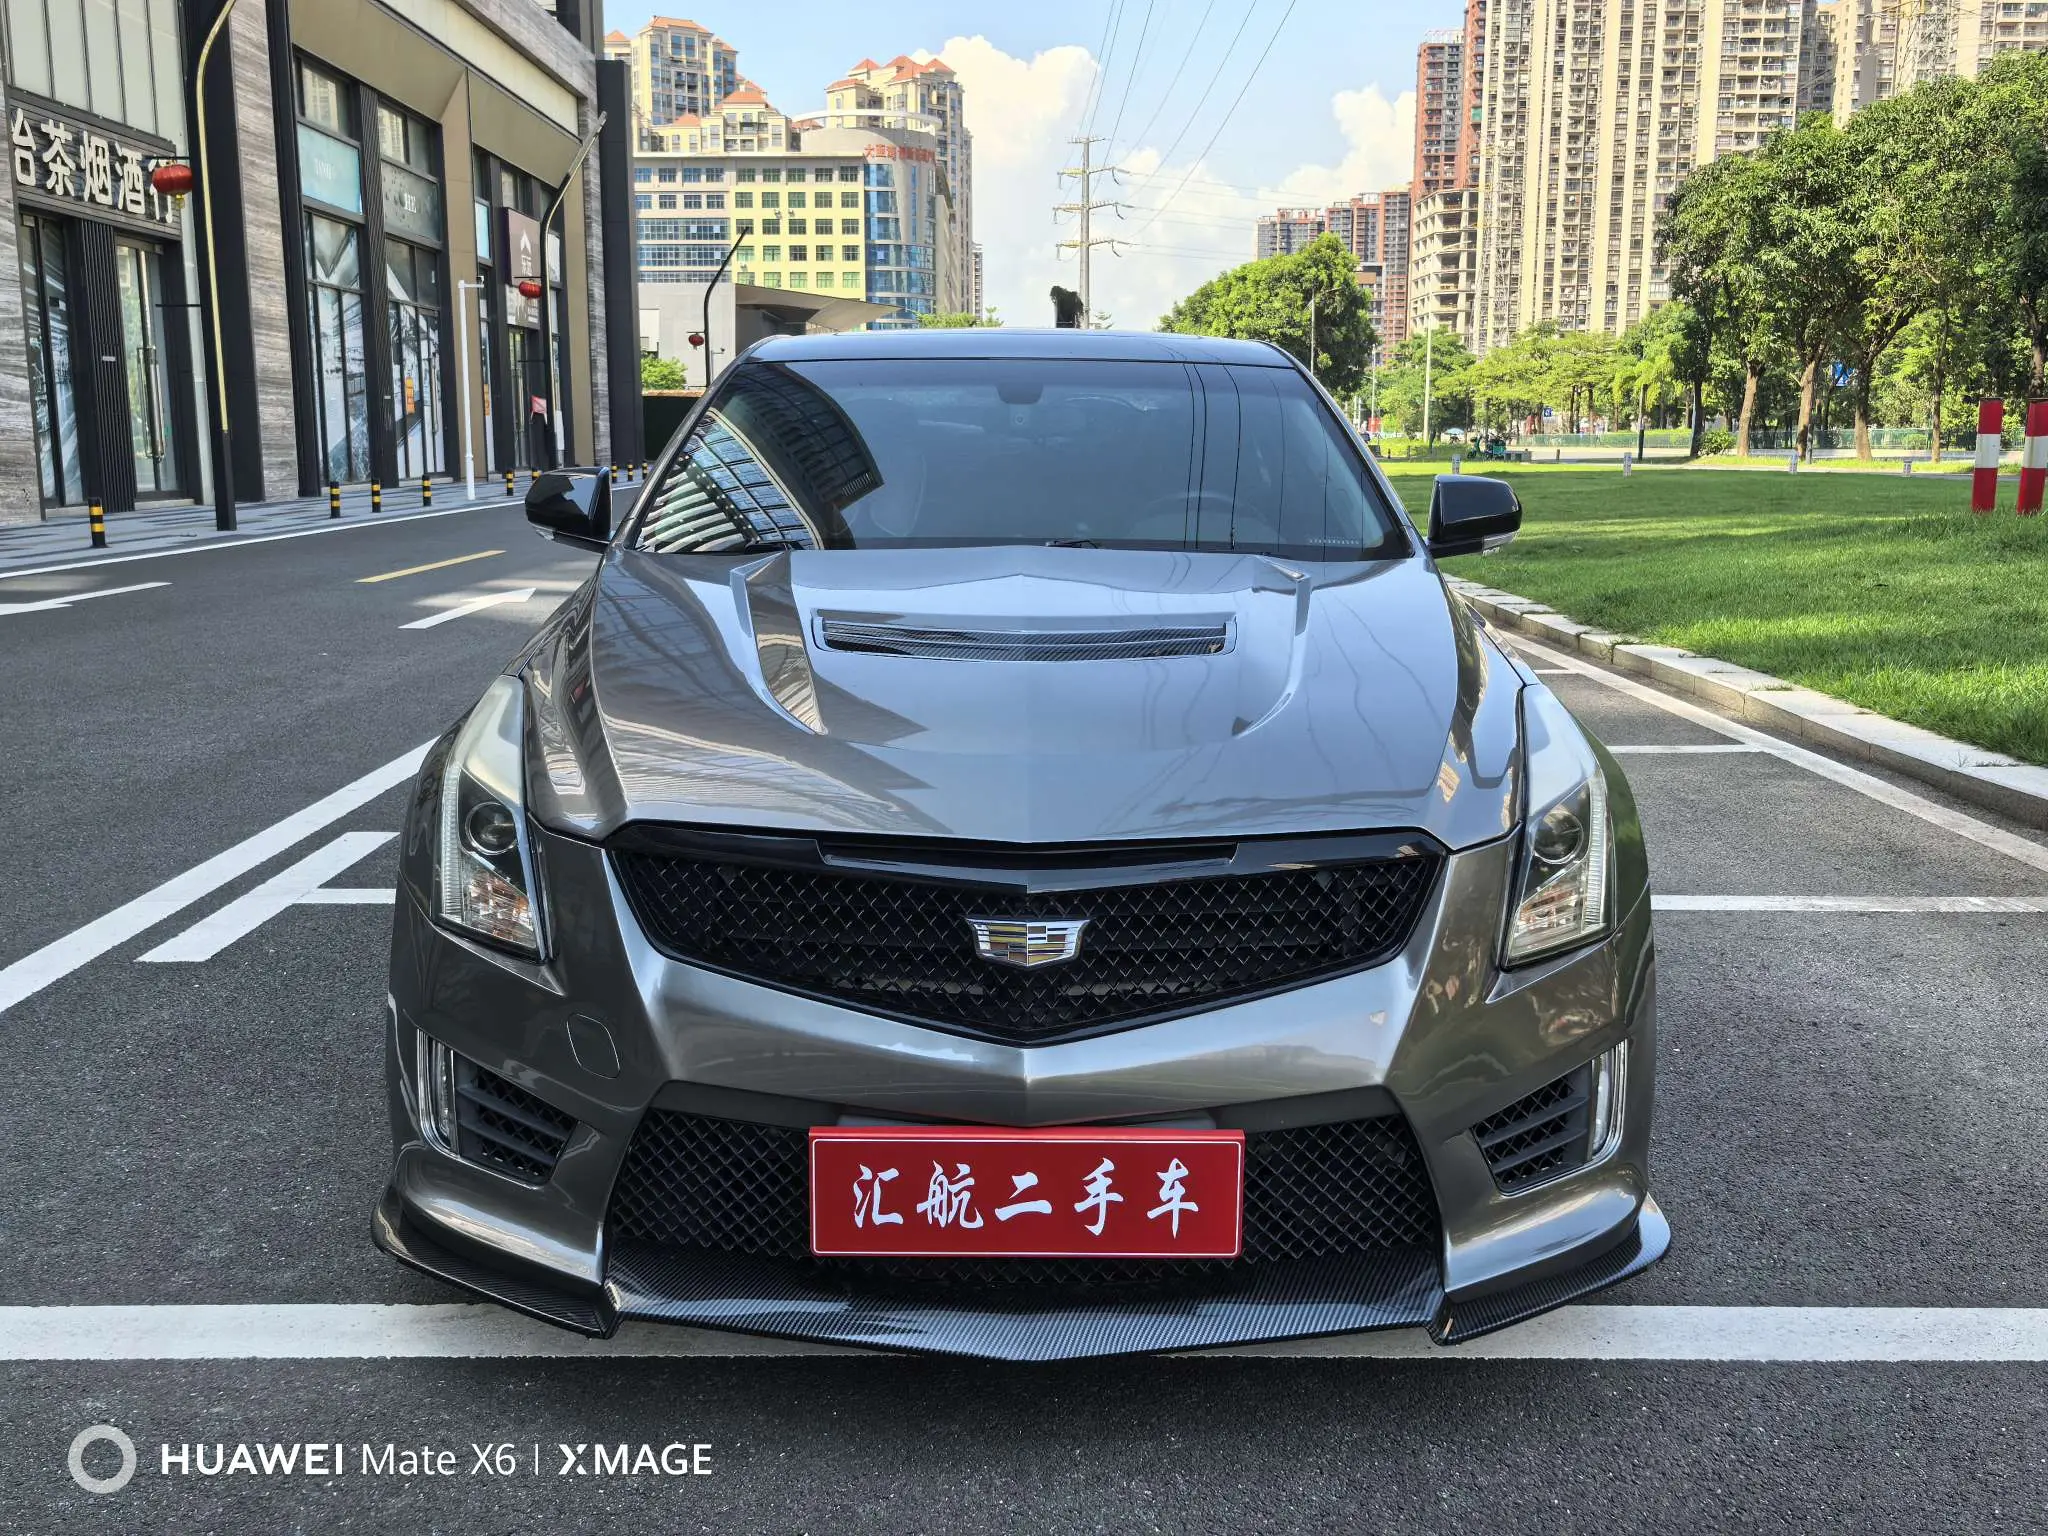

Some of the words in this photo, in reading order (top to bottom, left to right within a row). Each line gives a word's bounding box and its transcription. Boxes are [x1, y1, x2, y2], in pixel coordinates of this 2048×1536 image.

[853, 1157, 1199, 1239] 汇航二手车
